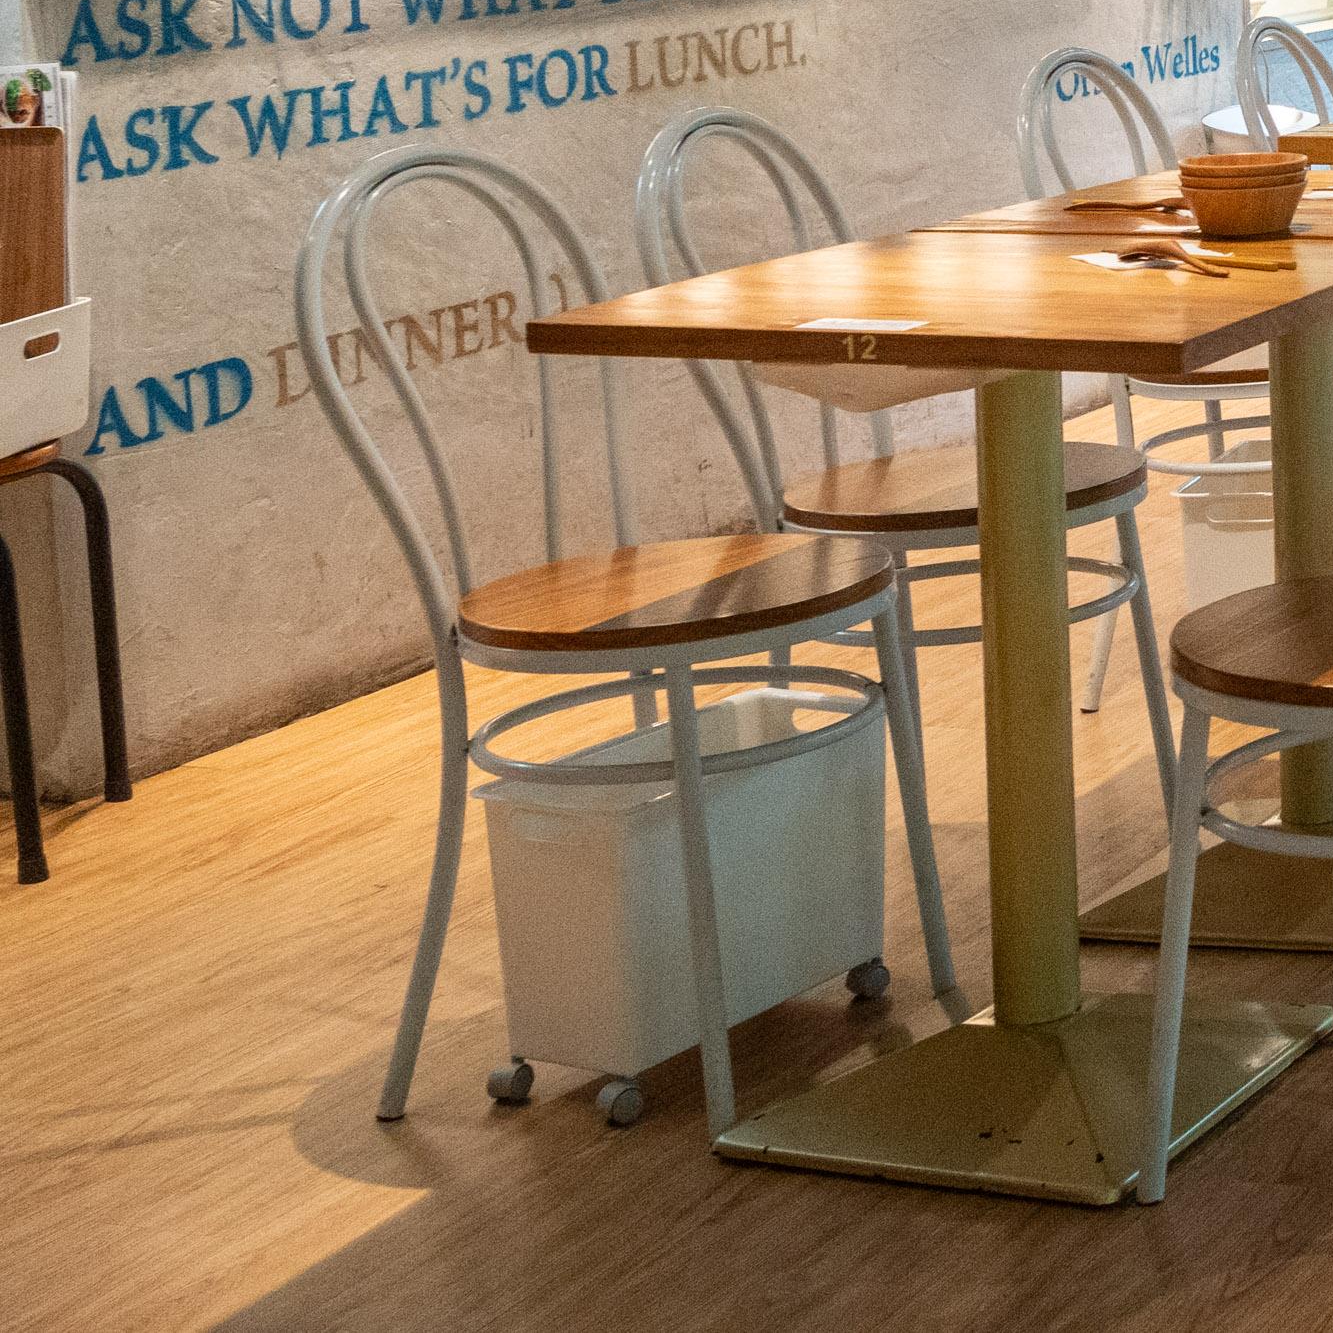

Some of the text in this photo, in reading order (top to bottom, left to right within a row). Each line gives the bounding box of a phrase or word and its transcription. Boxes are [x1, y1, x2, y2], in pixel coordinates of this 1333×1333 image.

[1140, 34, 1220, 84] Welles
[76, 20, 809, 183] ASK WHAT'S FOR LUNCH.
[842, 334, 878, 361] 12
[84, 356, 254, 456] AND
